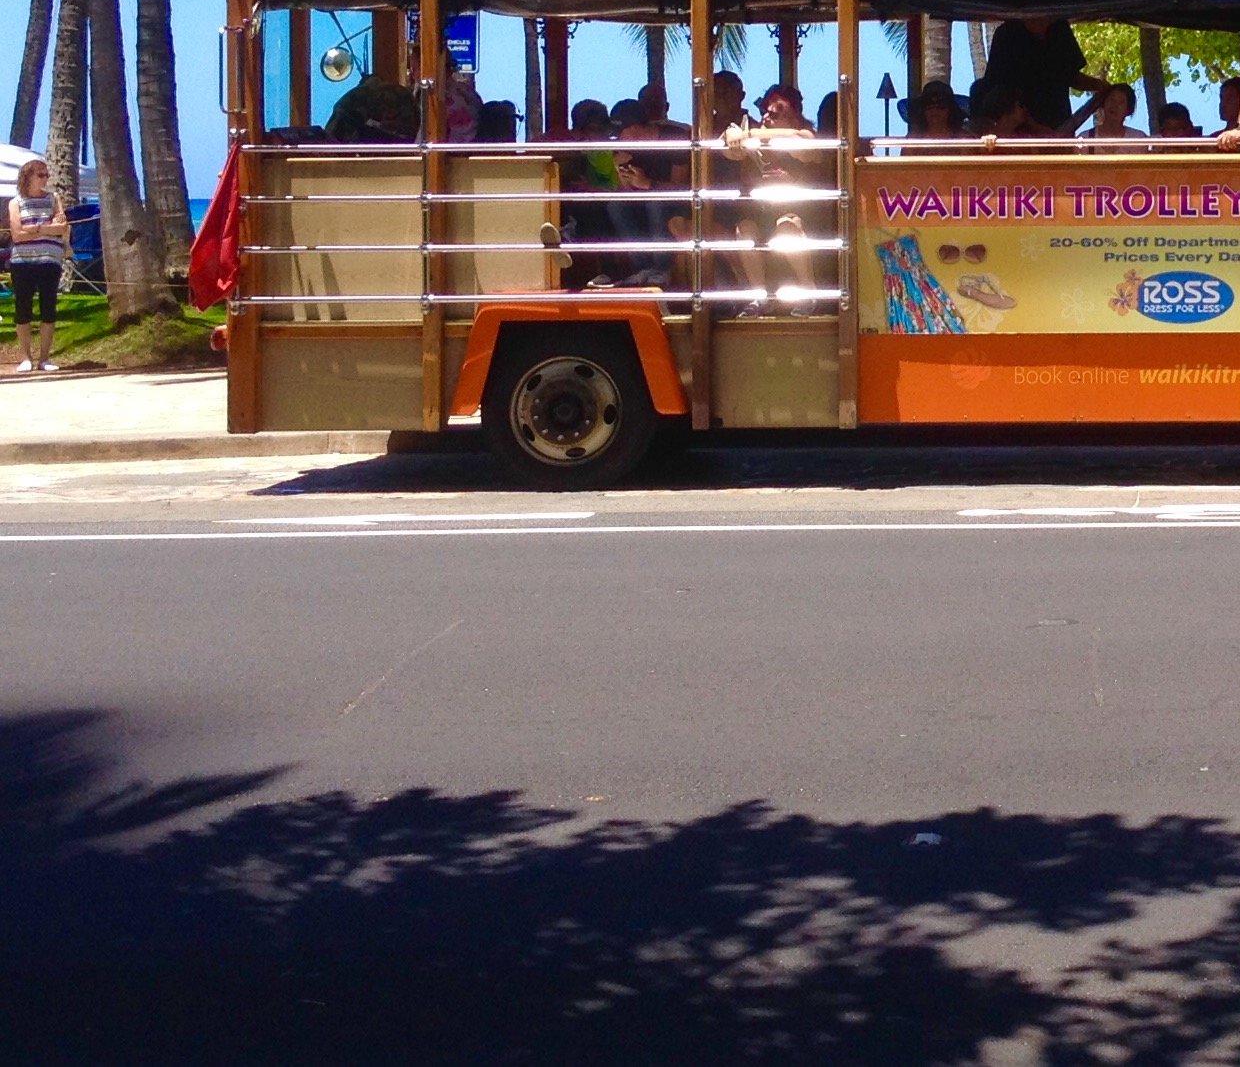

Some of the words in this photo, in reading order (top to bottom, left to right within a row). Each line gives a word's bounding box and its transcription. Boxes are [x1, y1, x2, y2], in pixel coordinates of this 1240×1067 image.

[878, 185, 1053, 220] WAIKIKI
[1050, 237, 1118, 248] 20-60%
[1123, 236, 1148, 247] Off
[1104, 251, 1159, 262] Prices
[1164, 252, 1212, 264] Every
[1143, 280, 1221, 304] ROSS
[1144, 305, 1173, 313] DRESS
[1176, 305, 1195, 313] FOR
[1013, 366, 1061, 384] Book
[1068, 366, 1129, 384] online
